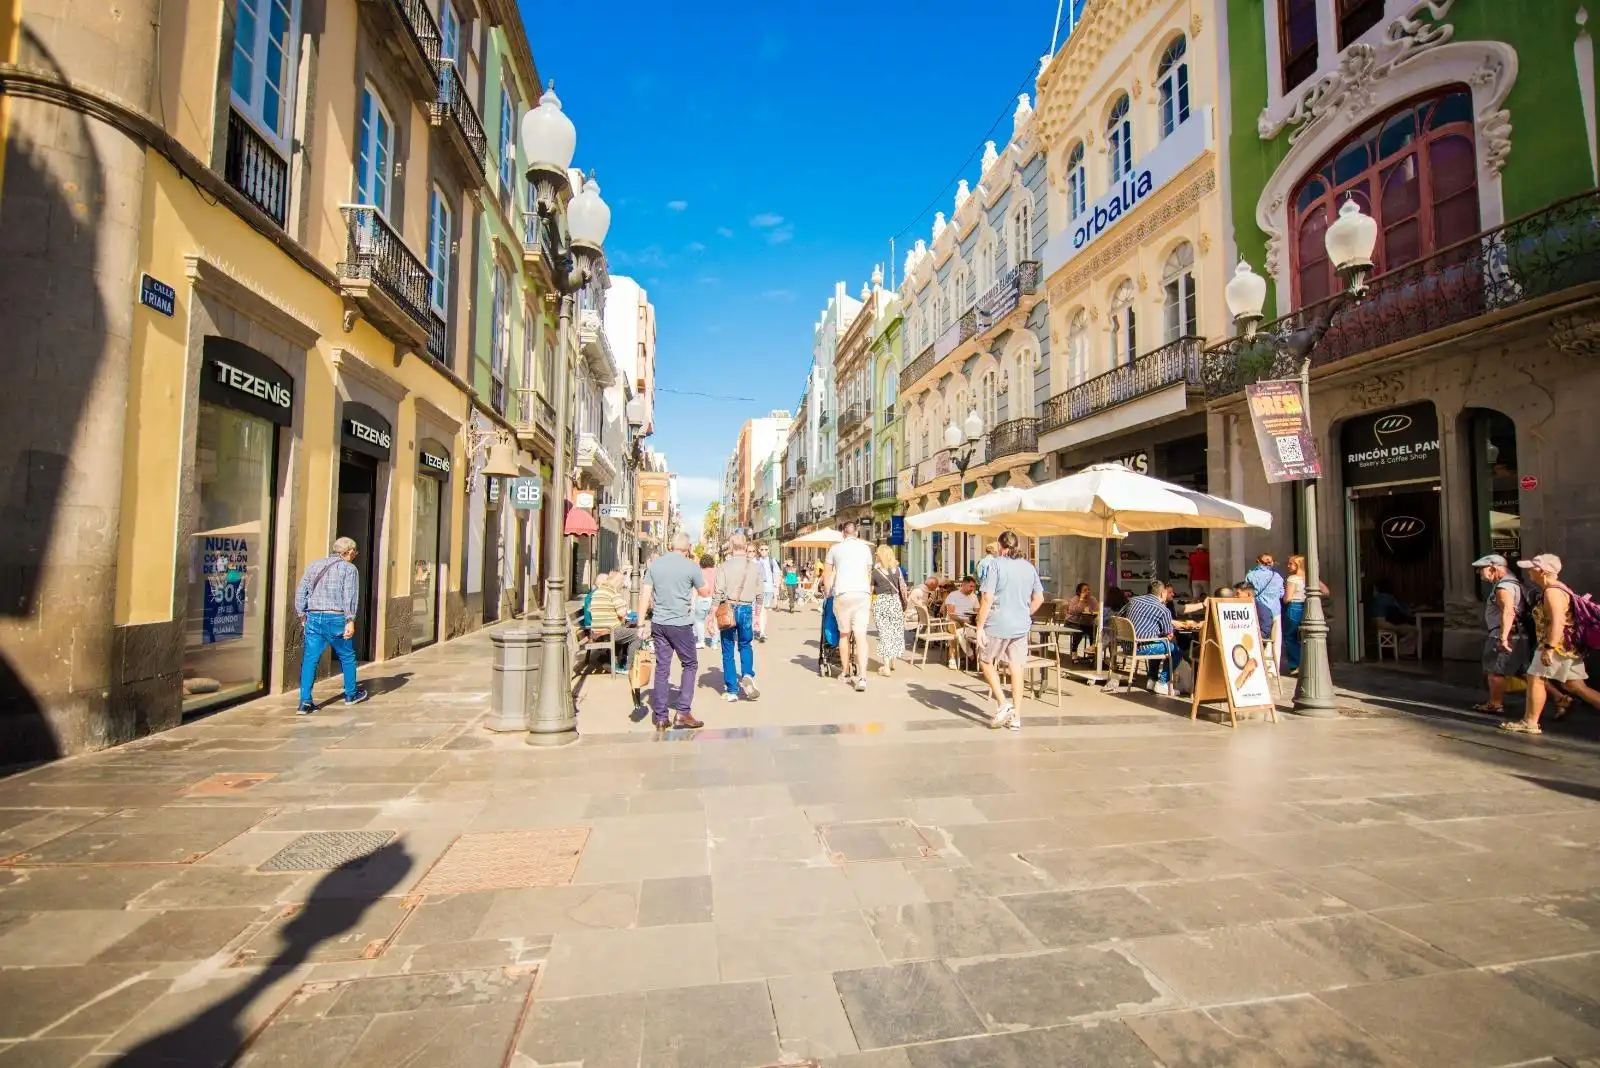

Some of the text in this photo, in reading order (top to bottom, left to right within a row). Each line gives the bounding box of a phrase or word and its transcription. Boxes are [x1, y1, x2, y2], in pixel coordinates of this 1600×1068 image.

[1073, 170, 1153, 249] orbalia
[153, 282, 174, 299] CALLE
[143, 289, 172, 314] TRIANA
[1347, 440, 1440, 464] RINCÓN DEL PAN
[1359, 459, 1379, 468] Bakery
[1386, 456, 1409, 464] Coffee
[1410, 453, 1428, 462] Shop
[205, 536, 248, 552] NUEVA
[204, 552, 248, 563] COCCIÓN
[210, 615, 239, 625] SEGUNDO
[1223, 606, 1250, 621] MENÚ
